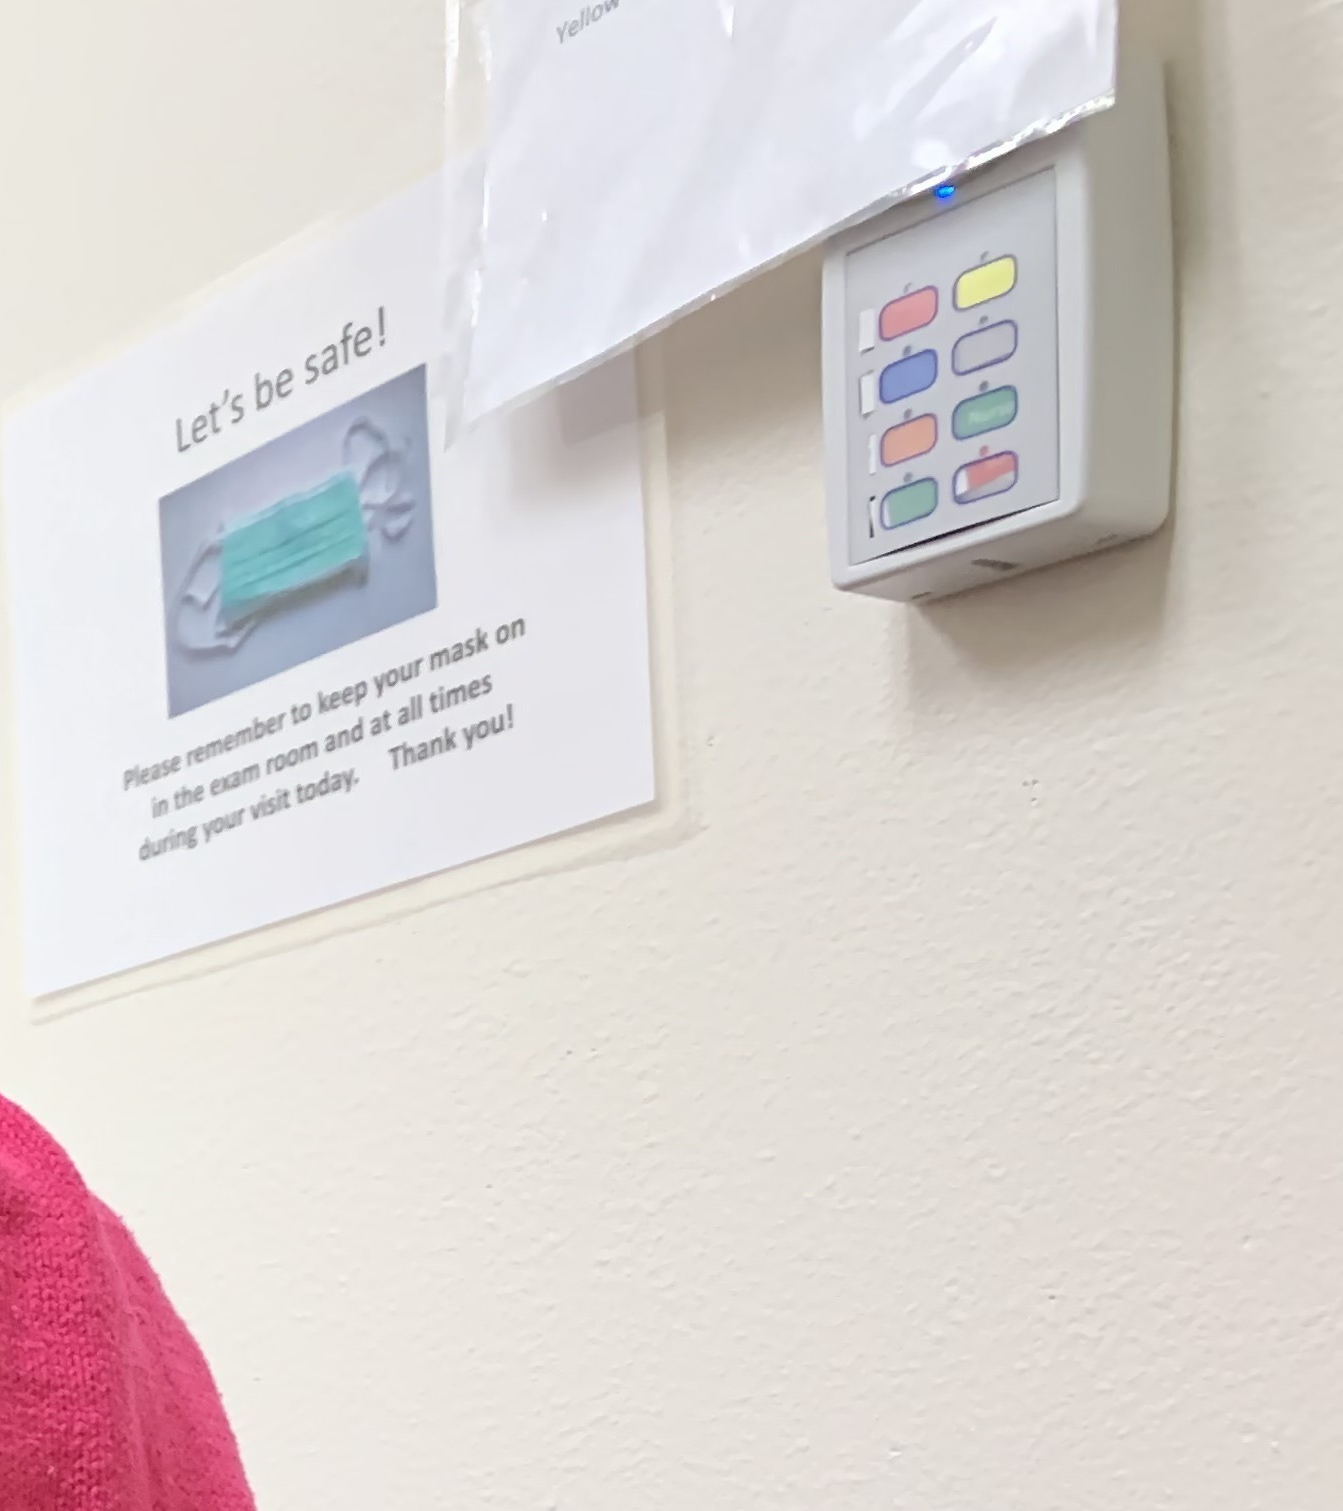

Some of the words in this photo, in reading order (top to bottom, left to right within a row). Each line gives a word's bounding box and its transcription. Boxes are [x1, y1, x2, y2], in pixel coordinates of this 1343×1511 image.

[254, 368, 294, 411] be
[304, 305, 386, 385] safe!
[123, 754, 182, 791] Please
[186, 712, 287, 767] remember
[290, 702, 313, 725] to
[317, 680, 368, 715] keep
[373, 656, 424, 698] your
[429, 627, 490, 671] mask
[494, 617, 525, 645] on
[151, 796, 169, 819] in
[173, 784, 205, 811] the
[209, 763, 260, 796] exam
[265, 740, 319, 775] room
[324, 716, 364, 753] and
[369, 709, 392, 737] at
[397, 693, 423, 727] all
[429, 673, 493, 714] times
[138, 828, 198, 861] during
[202, 807, 245, 844] your
[249, 788, 292, 820] visit
[295, 767, 359, 804] today.
[388, 726, 457, 771] Thank
[463, 703, 514, 750] you!
